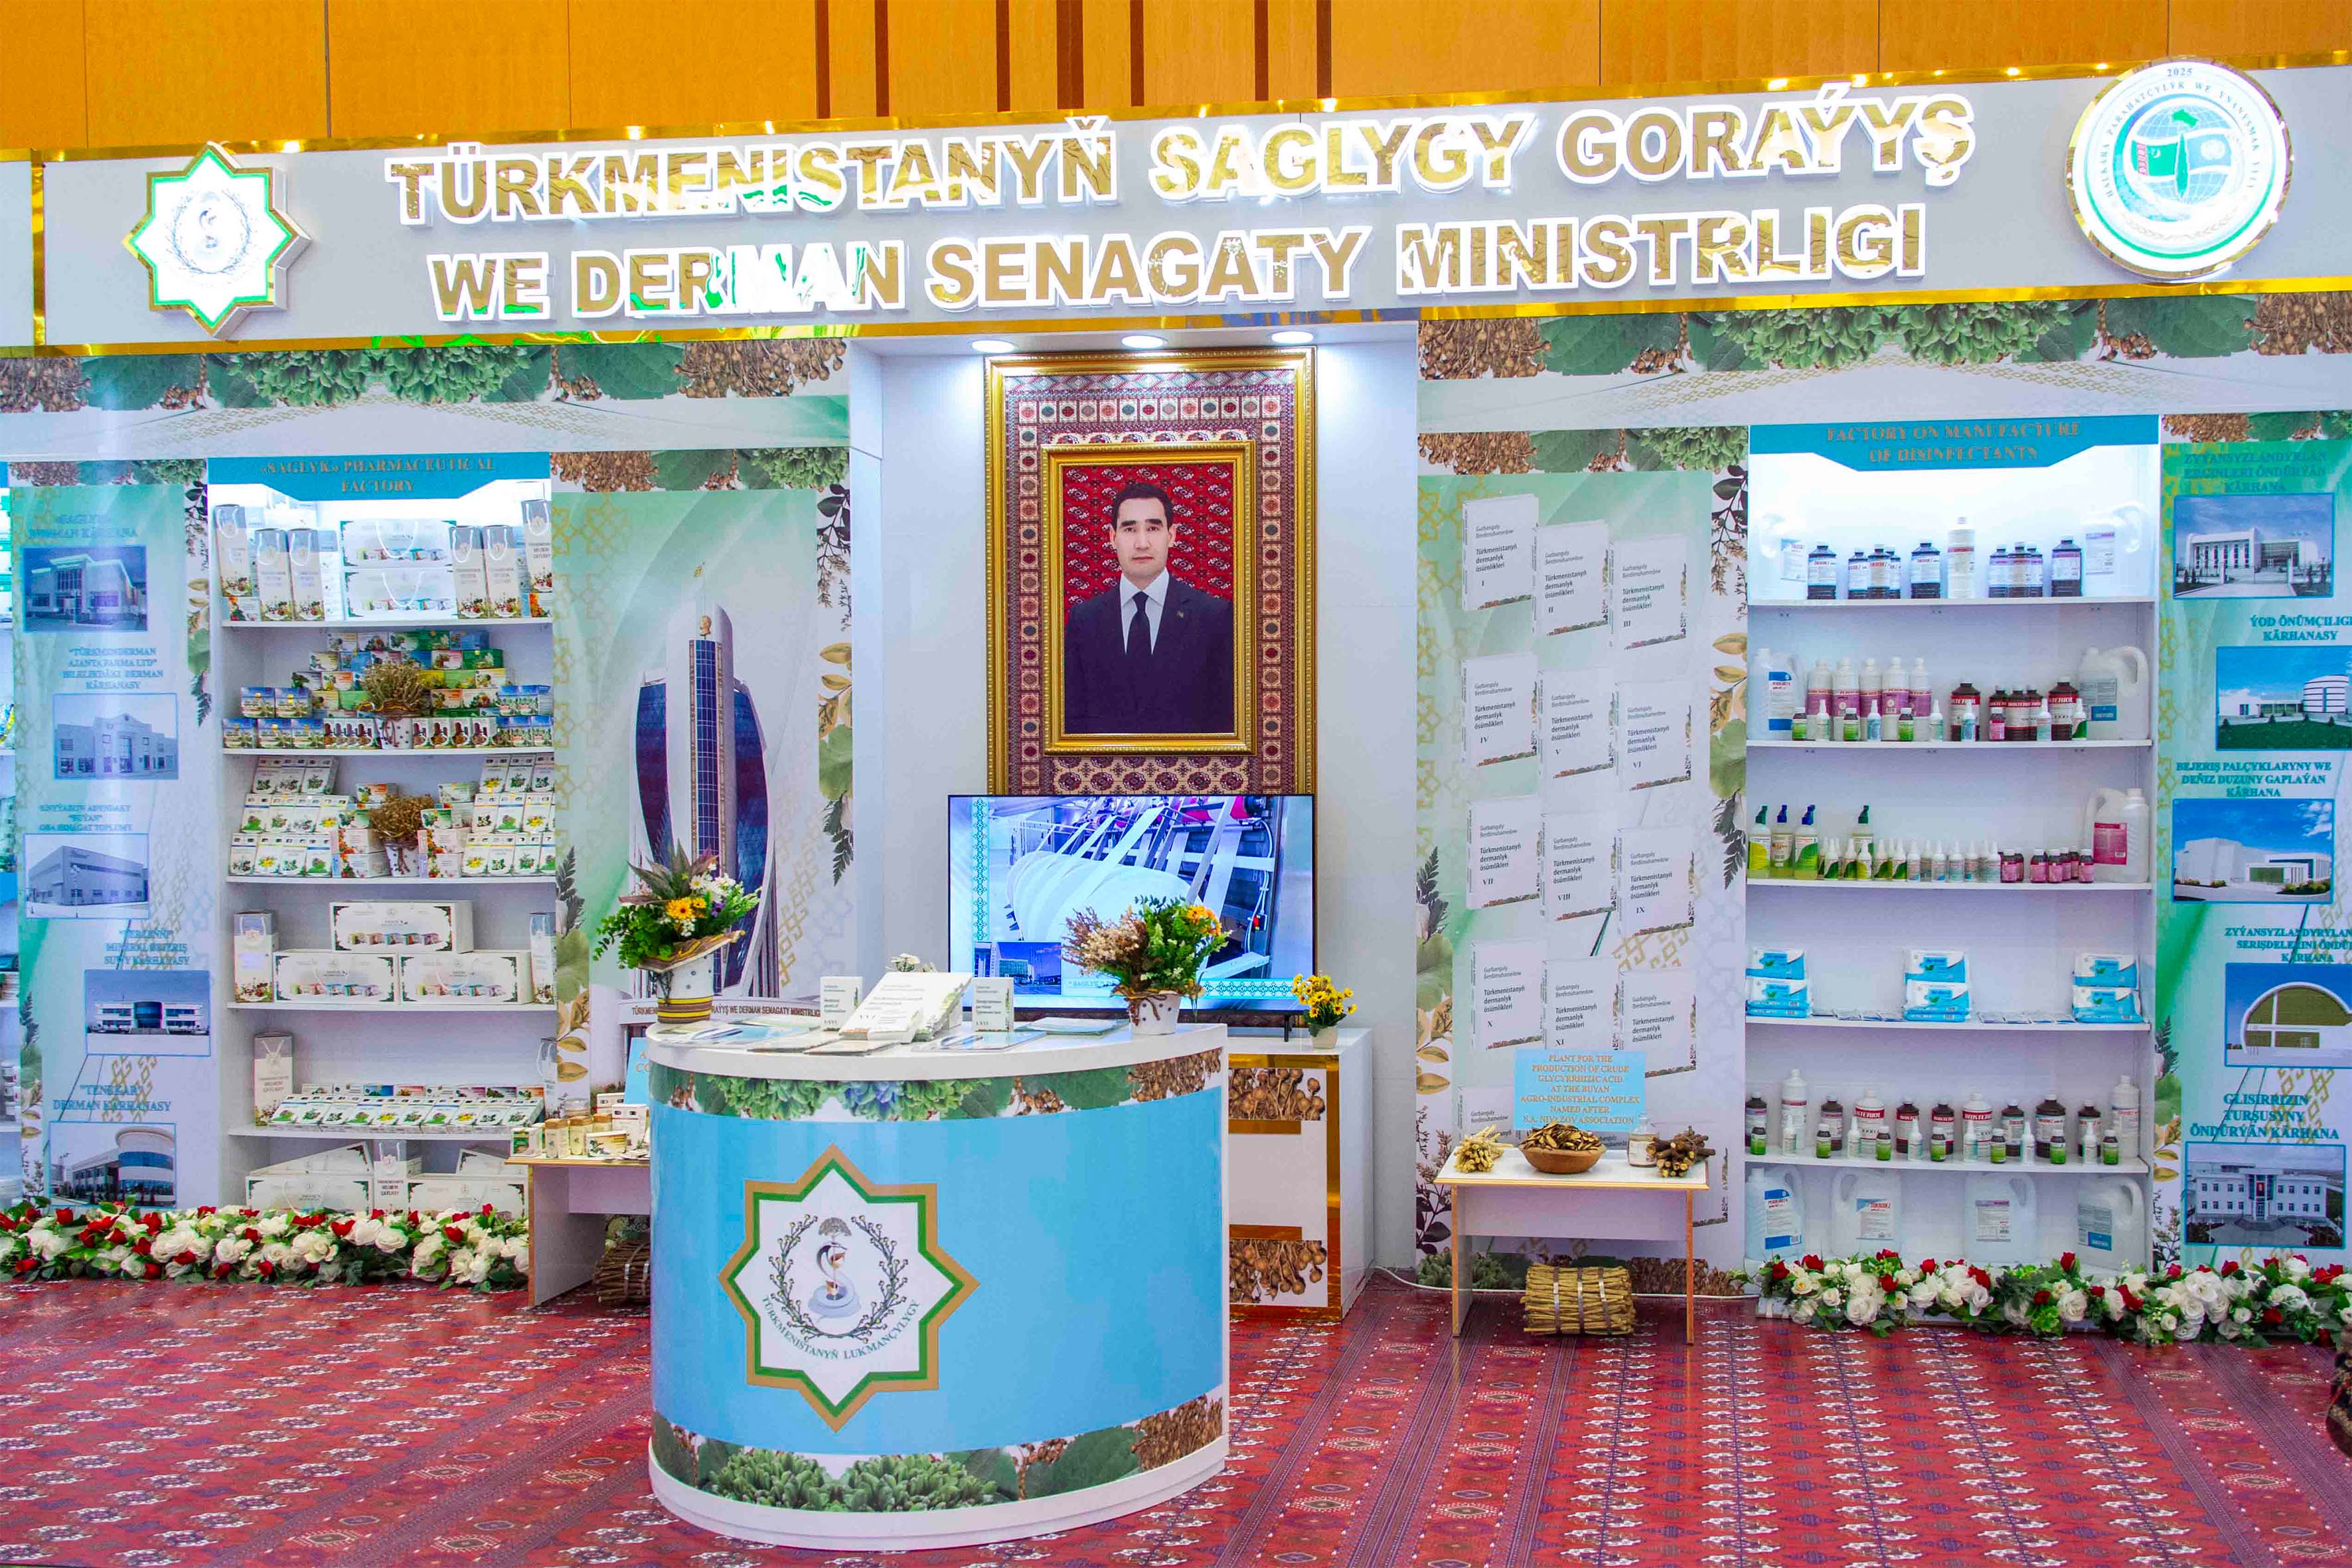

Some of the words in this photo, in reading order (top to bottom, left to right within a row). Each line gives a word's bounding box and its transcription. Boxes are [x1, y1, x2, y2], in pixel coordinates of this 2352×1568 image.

[2167, 67, 2193, 77] 2025
[386, 116, 1119, 226] TÜRKMENISTANYŇ
[1148, 110, 1533, 202] SAGLYGY
[1557, 81, 1976, 189] GORAÝYŞ
[426, 250, 551, 323] WE
[572, 238, 908, 317] DERMAN
[925, 224, 1370, 311] SENAGATY
[1395, 202, 1927, 298] MINISTRLIGI
[1827, 426, 1907, 441] FACTORY
[1913, 426, 1939, 439] ON
[1944, 422, 2080, 439] MANUFACTURE
[1869, 448, 1892, 463] OF
[1898, 445, 2038, 462] DISINFECTANTS
[344, 458, 494, 472] PHARMACEUTICAL
[342, 480, 414, 492] FACTORY
[1476, 554, 1504, 564] dermanlyk
[1545, 580, 1573, 590] dermanlyk
[1622, 594, 1650, 603] dermanlyk
[1474, 712, 1502, 720] dermanlyk
[1551, 724, 1579, 733] dermanlyk
[1627, 736, 1656, 745] dermanlyk
[2315, 762, 2331, 771] WE
[2266, 773, 2326, 784] GAPLAÝAN
[1480, 852, 1508, 862] dermanlyk
[1553, 866, 1581, 876] dermanlyk
[1630, 882, 1658, 891] dermanlyk
[1484, 995, 1512, 1004] dermanlyk
[791, 1007, 821, 1017] MINISTRLIG
[1555, 1013, 1584, 1023] dermanlyk
[1632, 1024, 1661, 1034] dermanlyk
[1532, 1064, 1586, 1073] PRODUCTION
[1582, 1085, 1609, 1093] BUYAN
[1521, 1095, 1597, 1103] AGRO-INDUSTRIAL
[1583, 1105, 1610, 1114] AFTER
[1579, 1115, 1634, 1124] ASSOCIATION
[762, 1296, 839, 1360] TÜRKMENISTANYŇ
[844, 1299, 921, 1360] LUKMANÇYLYGY
